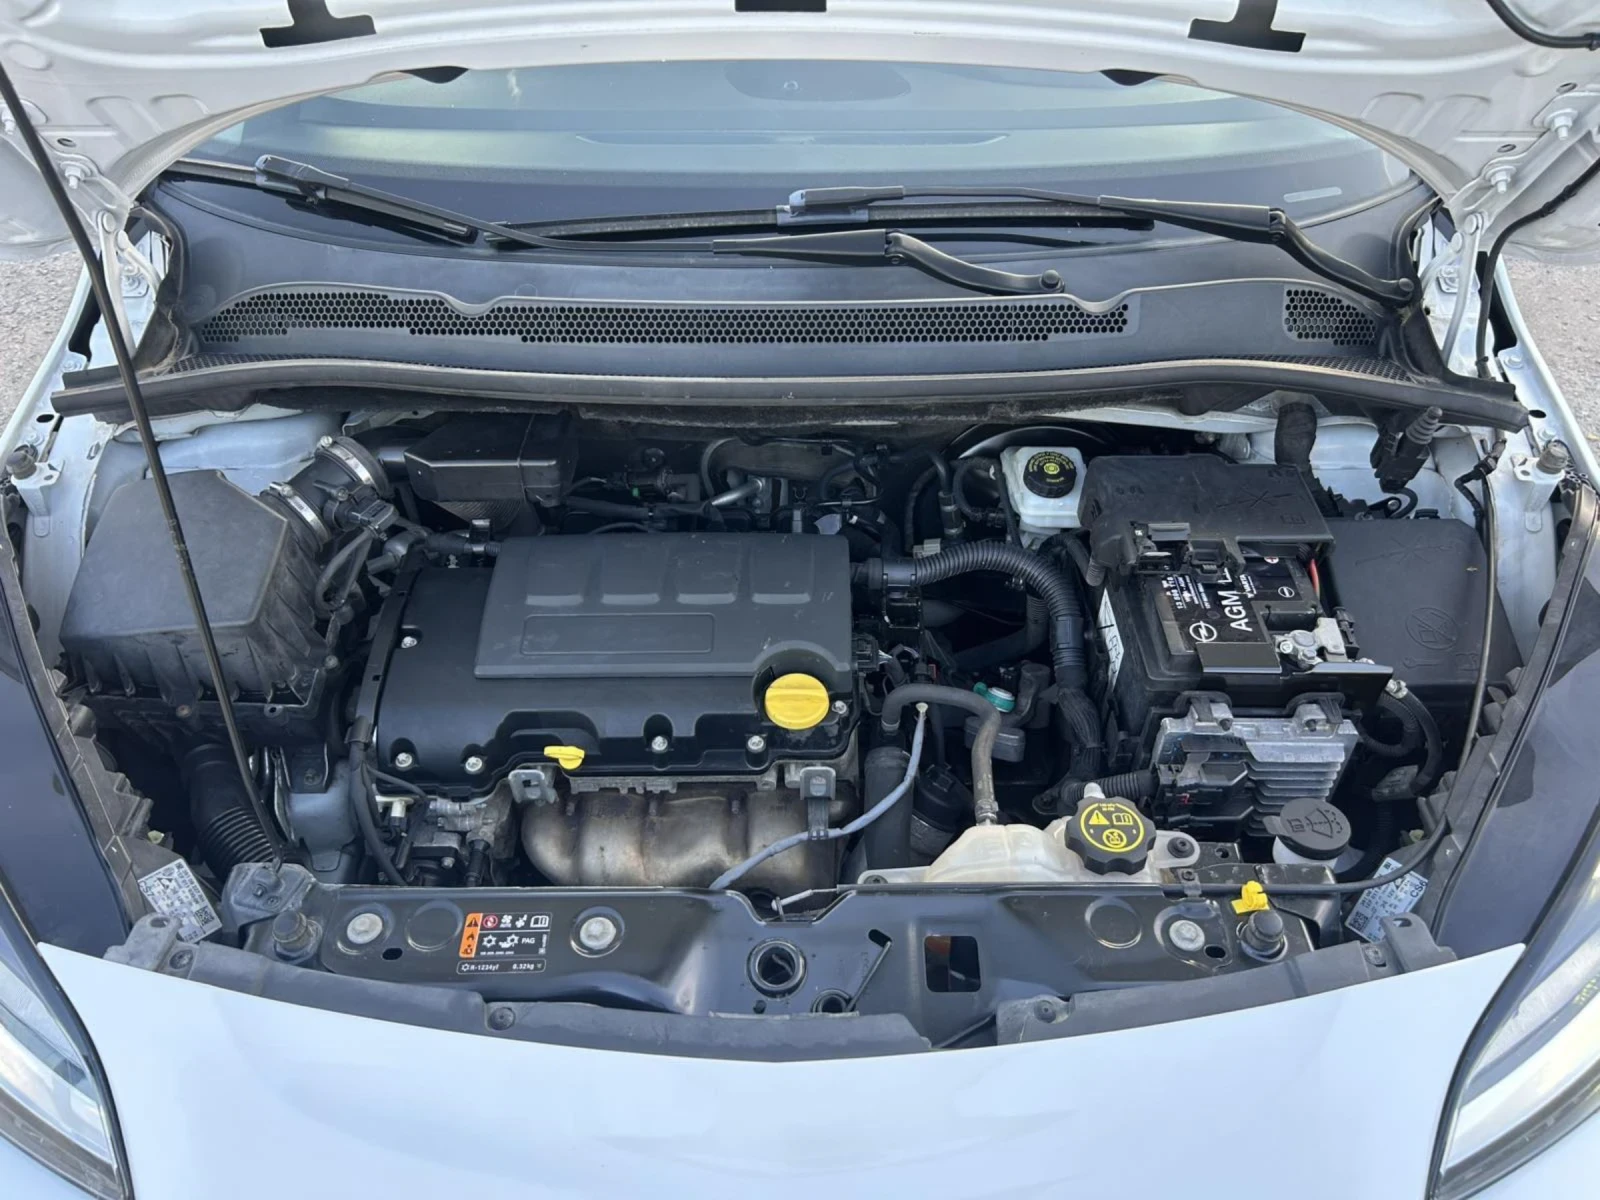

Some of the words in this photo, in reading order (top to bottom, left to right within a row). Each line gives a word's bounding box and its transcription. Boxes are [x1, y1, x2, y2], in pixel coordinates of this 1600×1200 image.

[1239, 574, 1251, 593] VARTA
[1217, 590, 1253, 632] AGM
[1409, 877, 1428, 899] CS6
[469, 963, 500, 971] R-1234yf
